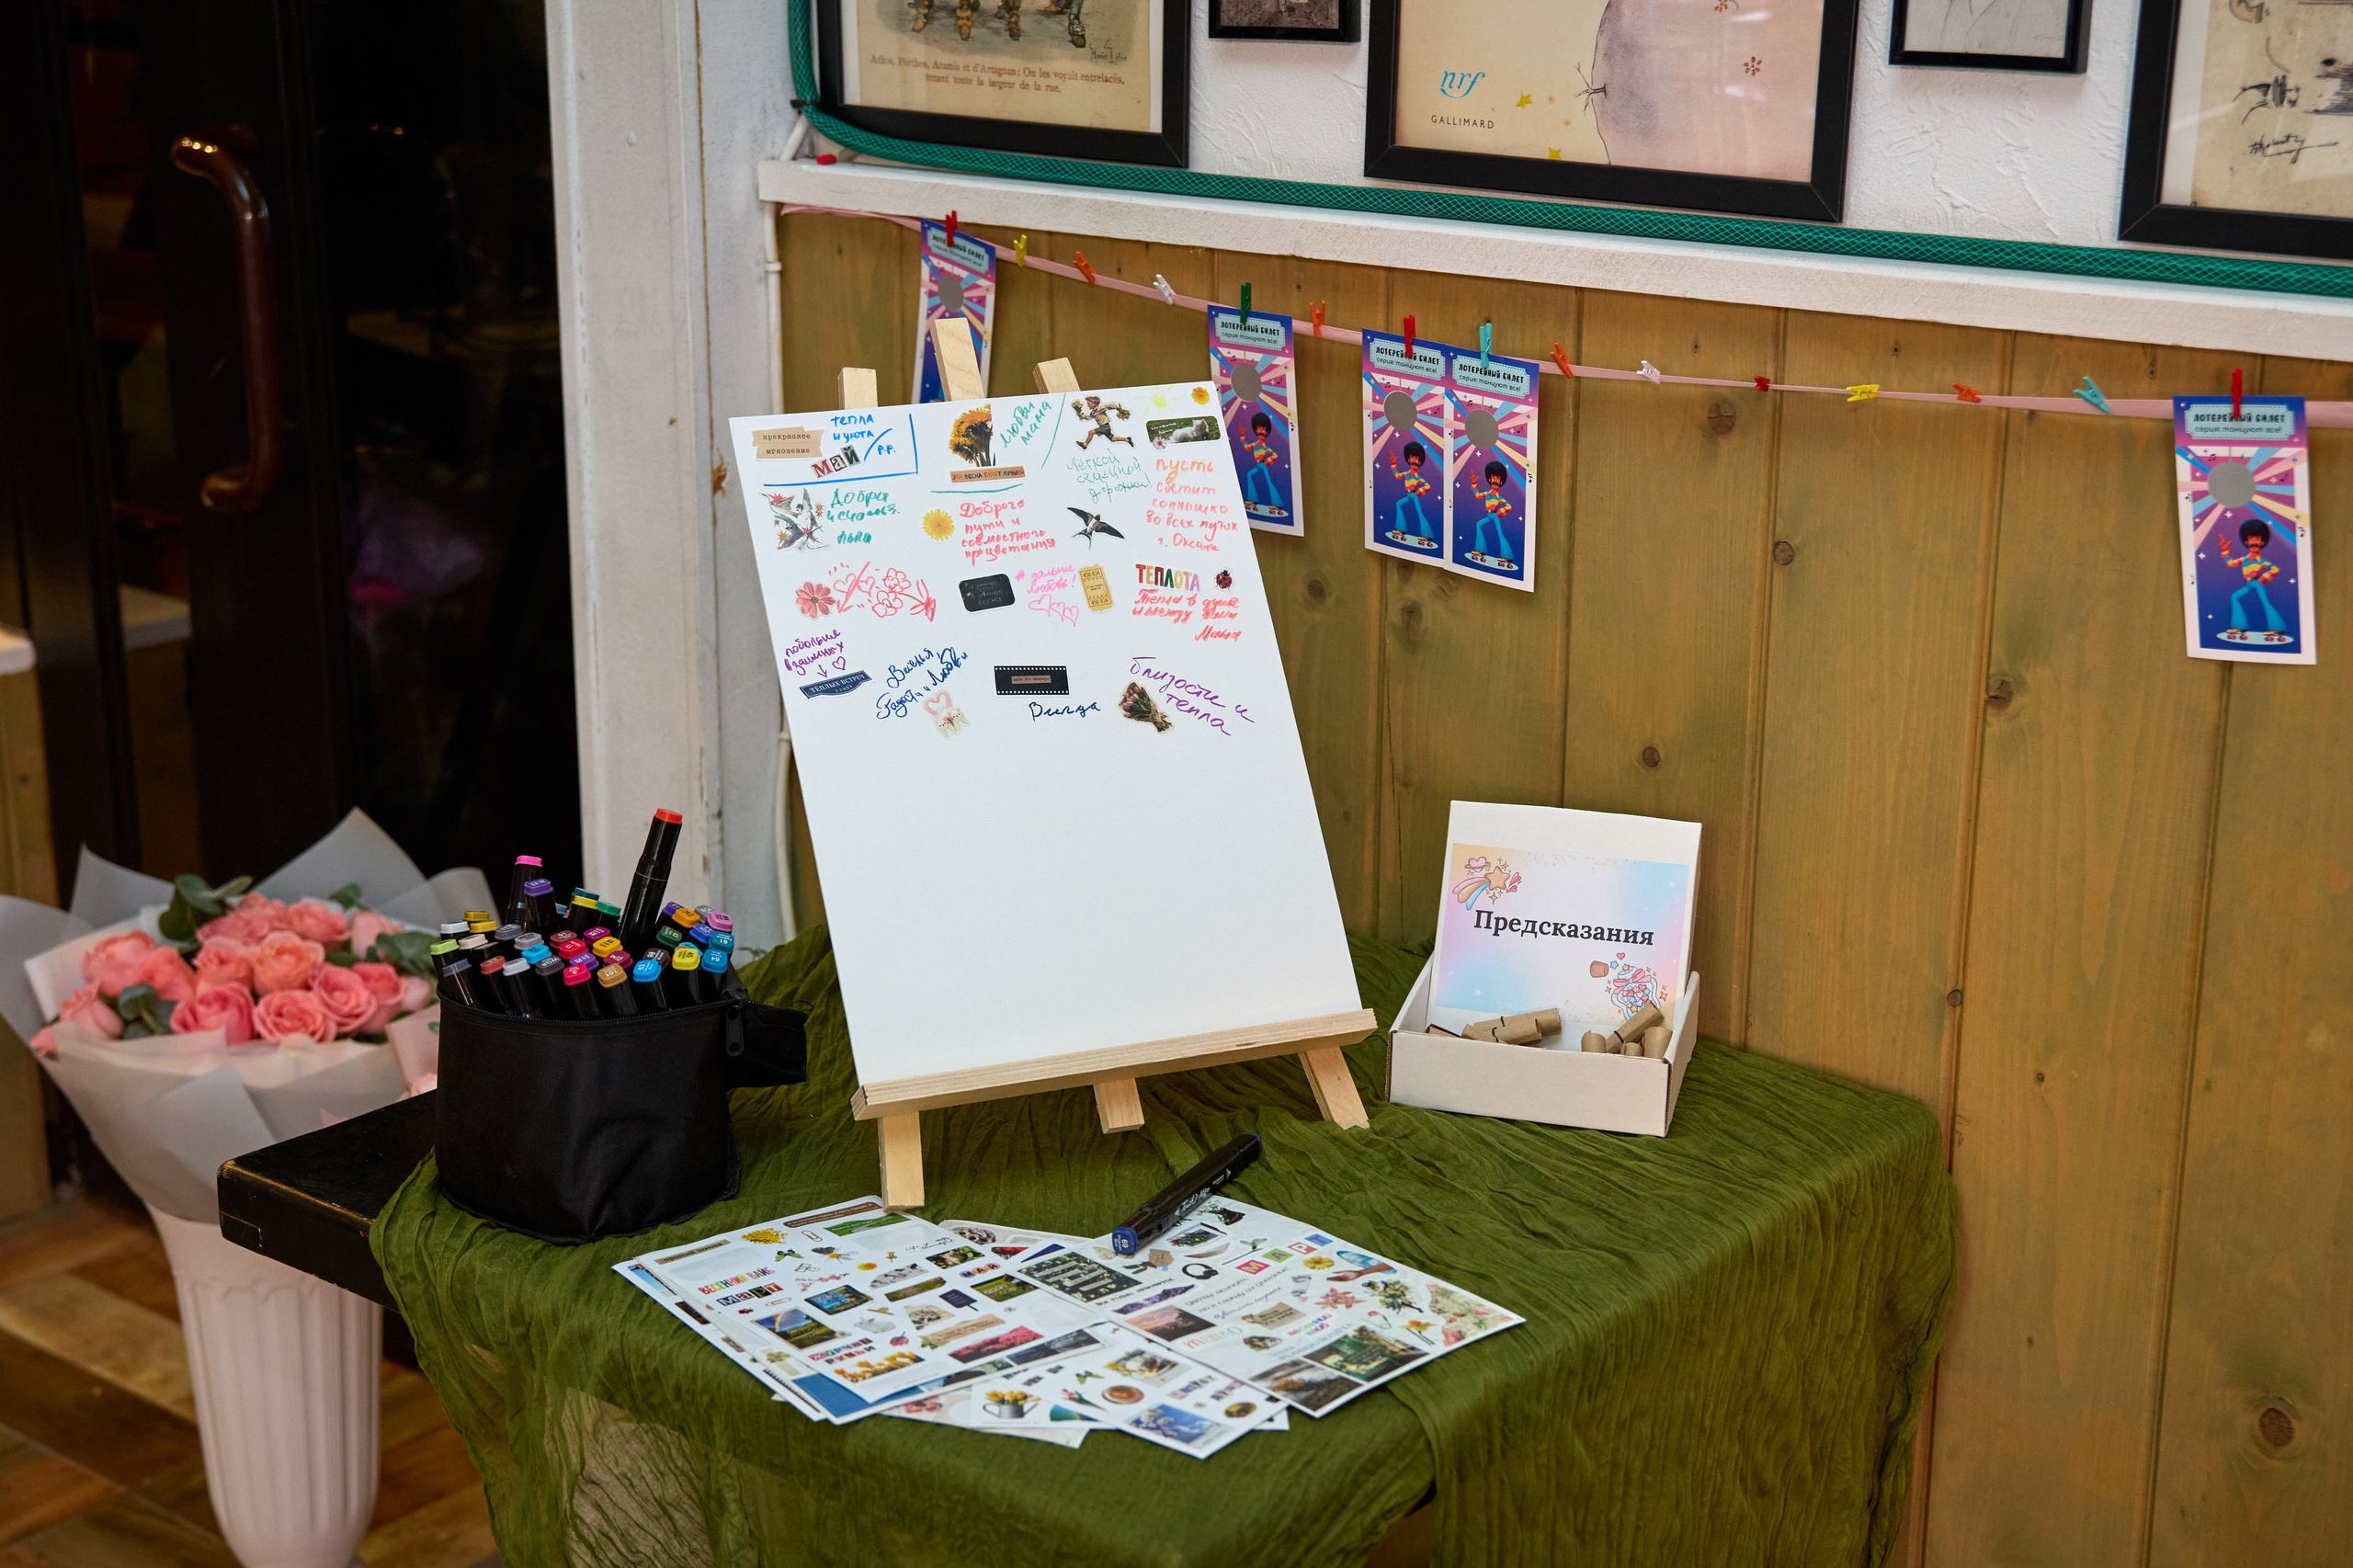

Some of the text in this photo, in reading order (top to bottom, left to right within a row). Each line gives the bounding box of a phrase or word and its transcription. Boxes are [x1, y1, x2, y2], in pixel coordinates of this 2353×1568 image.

[1023, 67, 1037, 77] On
[1039, 68, 1050, 79] les
[1053, 70, 1078, 83] voyait
[1019, 80, 1029, 90] de
[1034, 81, 1041, 91] la
[1439, 70, 1485, 98] nrf
[1431, 114, 1495, 130] GALLIMARD
[1261, 328, 1279, 336] БИЛЕТ
[1396, 361, 1425, 369] танцуют
[1419, 355, 1439, 366] БИЛЕТ
[1458, 364, 1524, 384] ЛОТЕРЕЙНЫЙ БИЛЕТ
[1479, 379, 1507, 390] танцуют
[2256, 415, 2285, 423] БИЛЕТ
[763, 433, 811, 441] прекрасное
[1135, 563, 1200, 593] ТЕПЛОТА
[810, 674, 866, 693] ТЁПЛЫХ ВСТРЕЧ
[1473, 909, 1654, 946] Предсказания
[1121, 1239, 1129, 1248] 69
[1241, 1234, 1331, 1273] МАРТ
[699, 1267, 776, 1296] ВЕСЕННИЙ ВАЙБ
